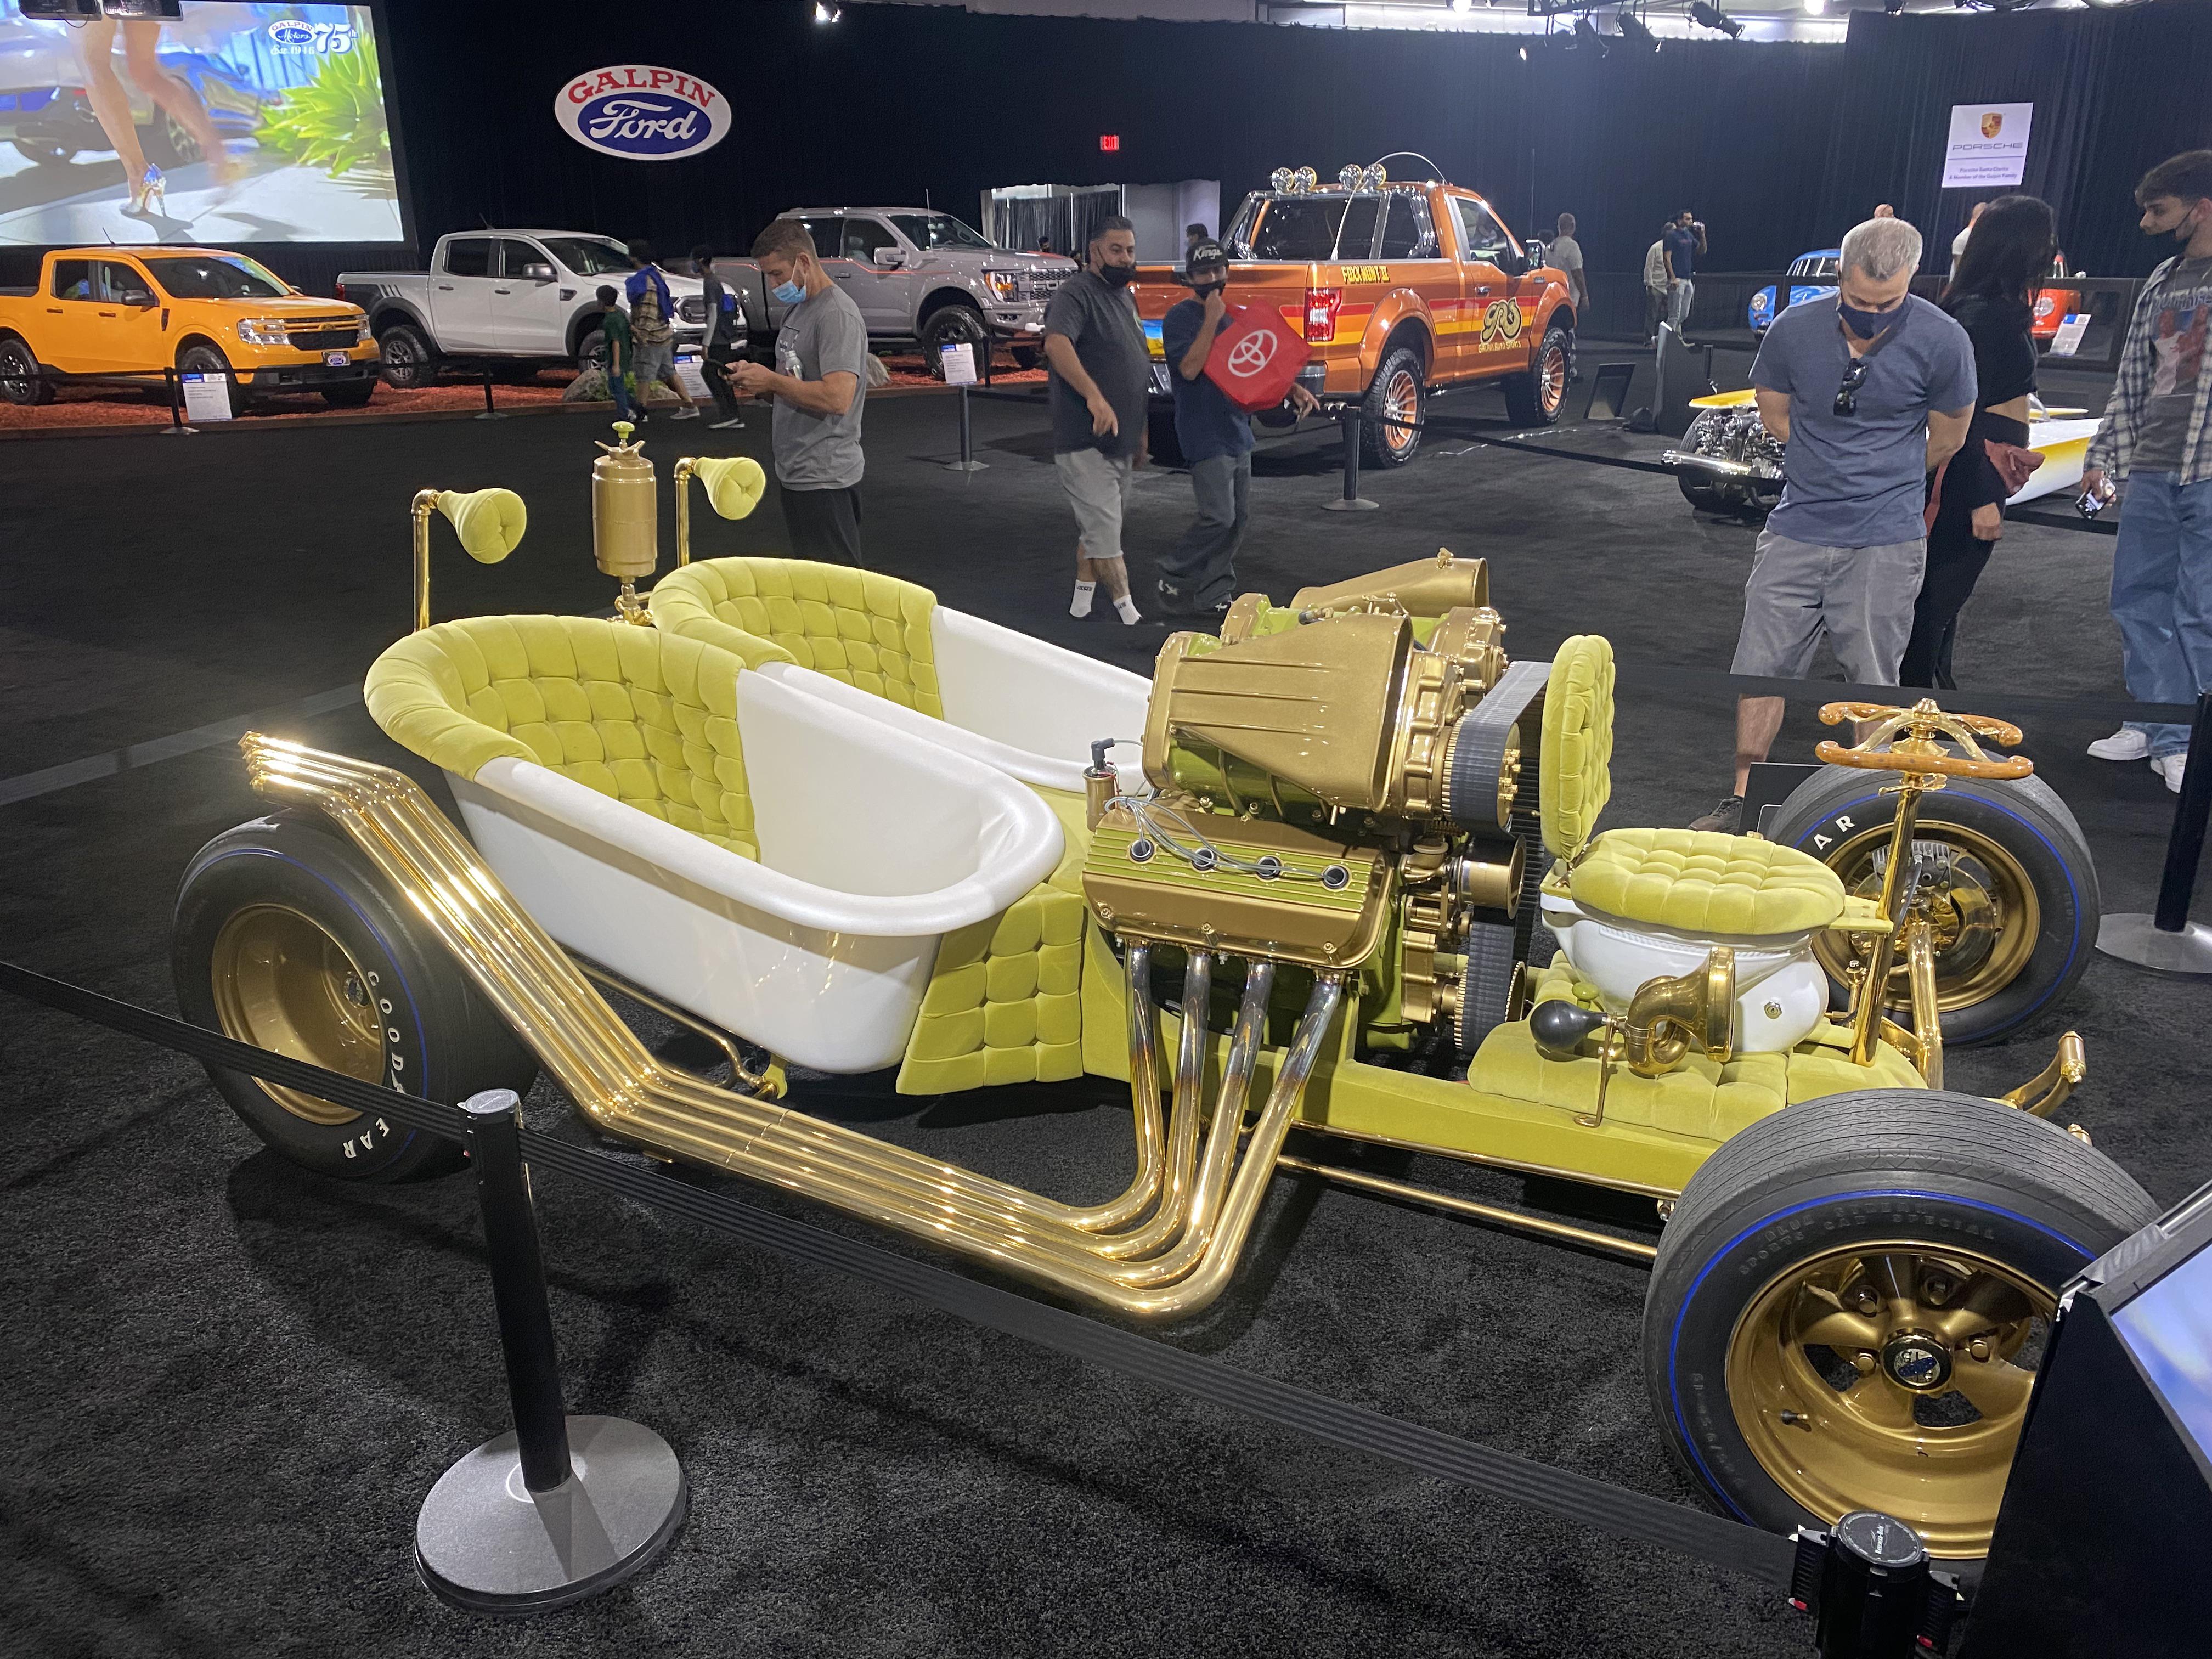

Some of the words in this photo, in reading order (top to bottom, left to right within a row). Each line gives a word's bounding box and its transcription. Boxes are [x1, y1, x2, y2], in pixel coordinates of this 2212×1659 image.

[272, 21, 312, 31] GALPIN
[278, 29, 311, 43] Motors
[568, 69, 715, 108] GALPIN
[589, 100, 697, 139] Ford
[1953, 142, 2023, 151] PORSCHE
[1823, 1215, 1867, 1231] CAR
[1892, 1213, 1995, 1240] SPECIAL
